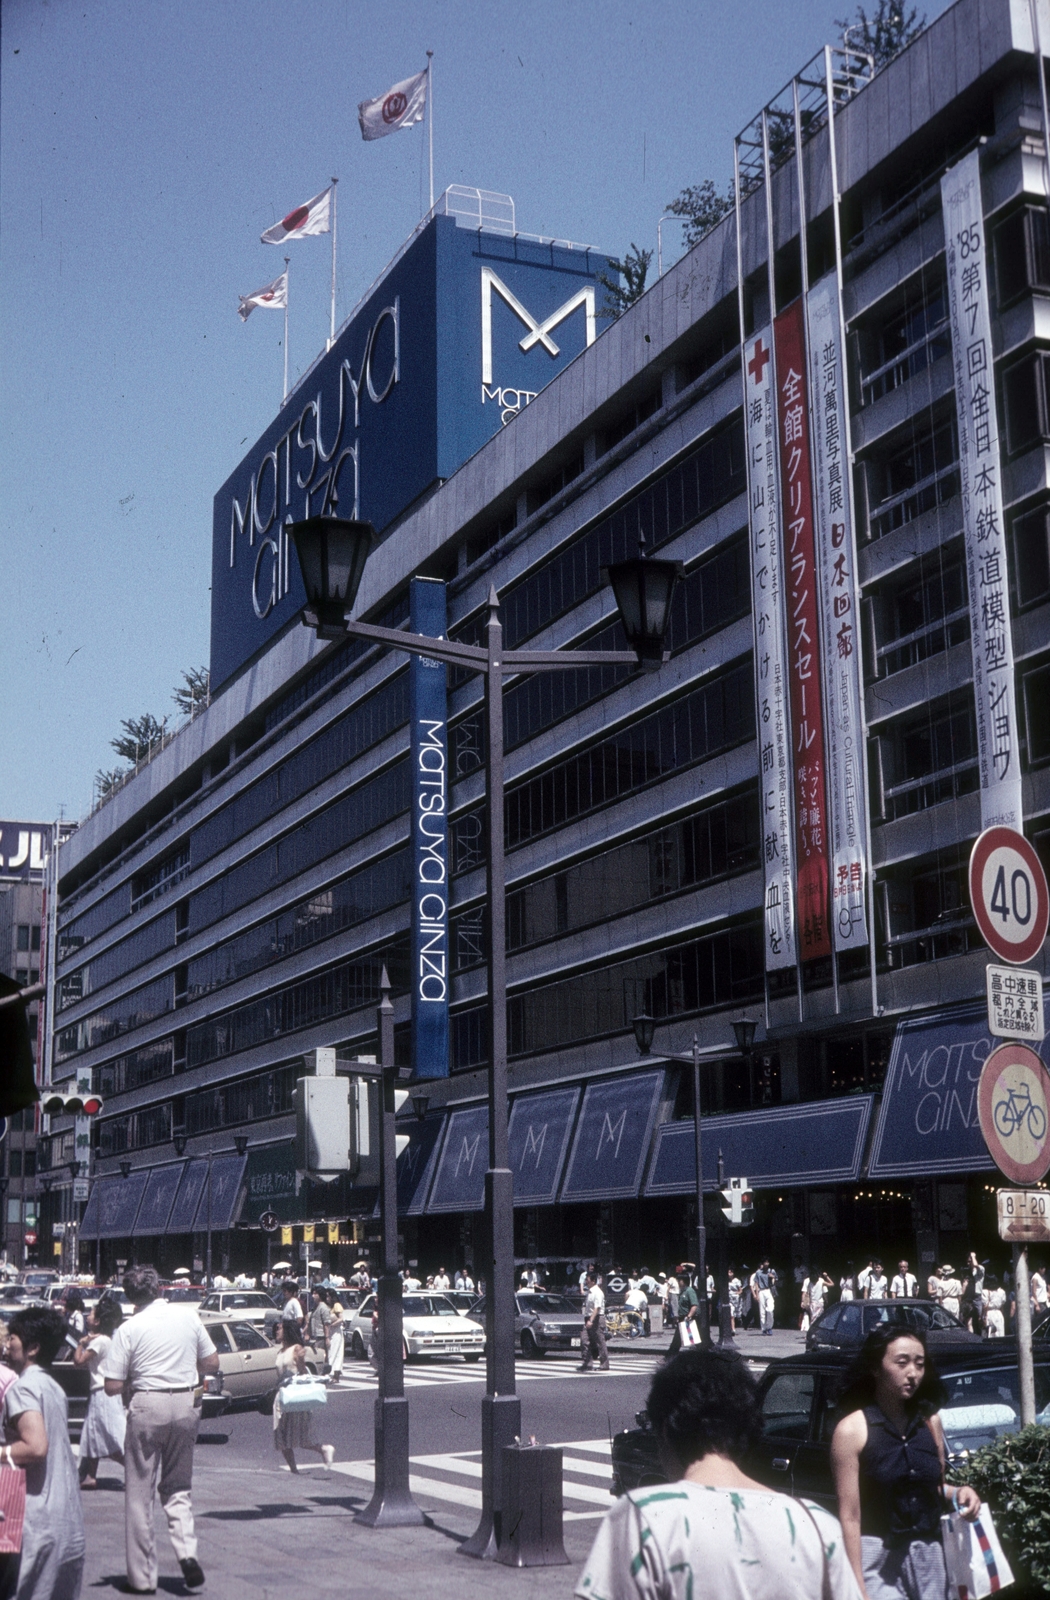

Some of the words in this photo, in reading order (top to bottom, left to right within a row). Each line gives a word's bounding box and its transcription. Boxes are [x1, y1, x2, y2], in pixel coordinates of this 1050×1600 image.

[822, 339, 844, 515] 並河萬里写真展
[782, 367, 816, 753] 全館クリアランスセール
[830, 523, 853, 660] 日本回廊
[749, 397, 781, 956] 海に山にでかける前に献血を
[841, 670, 850, 711] Japan
[843, 715, 850, 733] as
[844, 736, 854, 790] Cultural
[846, 790, 856, 848] Triangle
[837, 862, 861, 885] 予告
[990, 864, 1032, 927] 40
